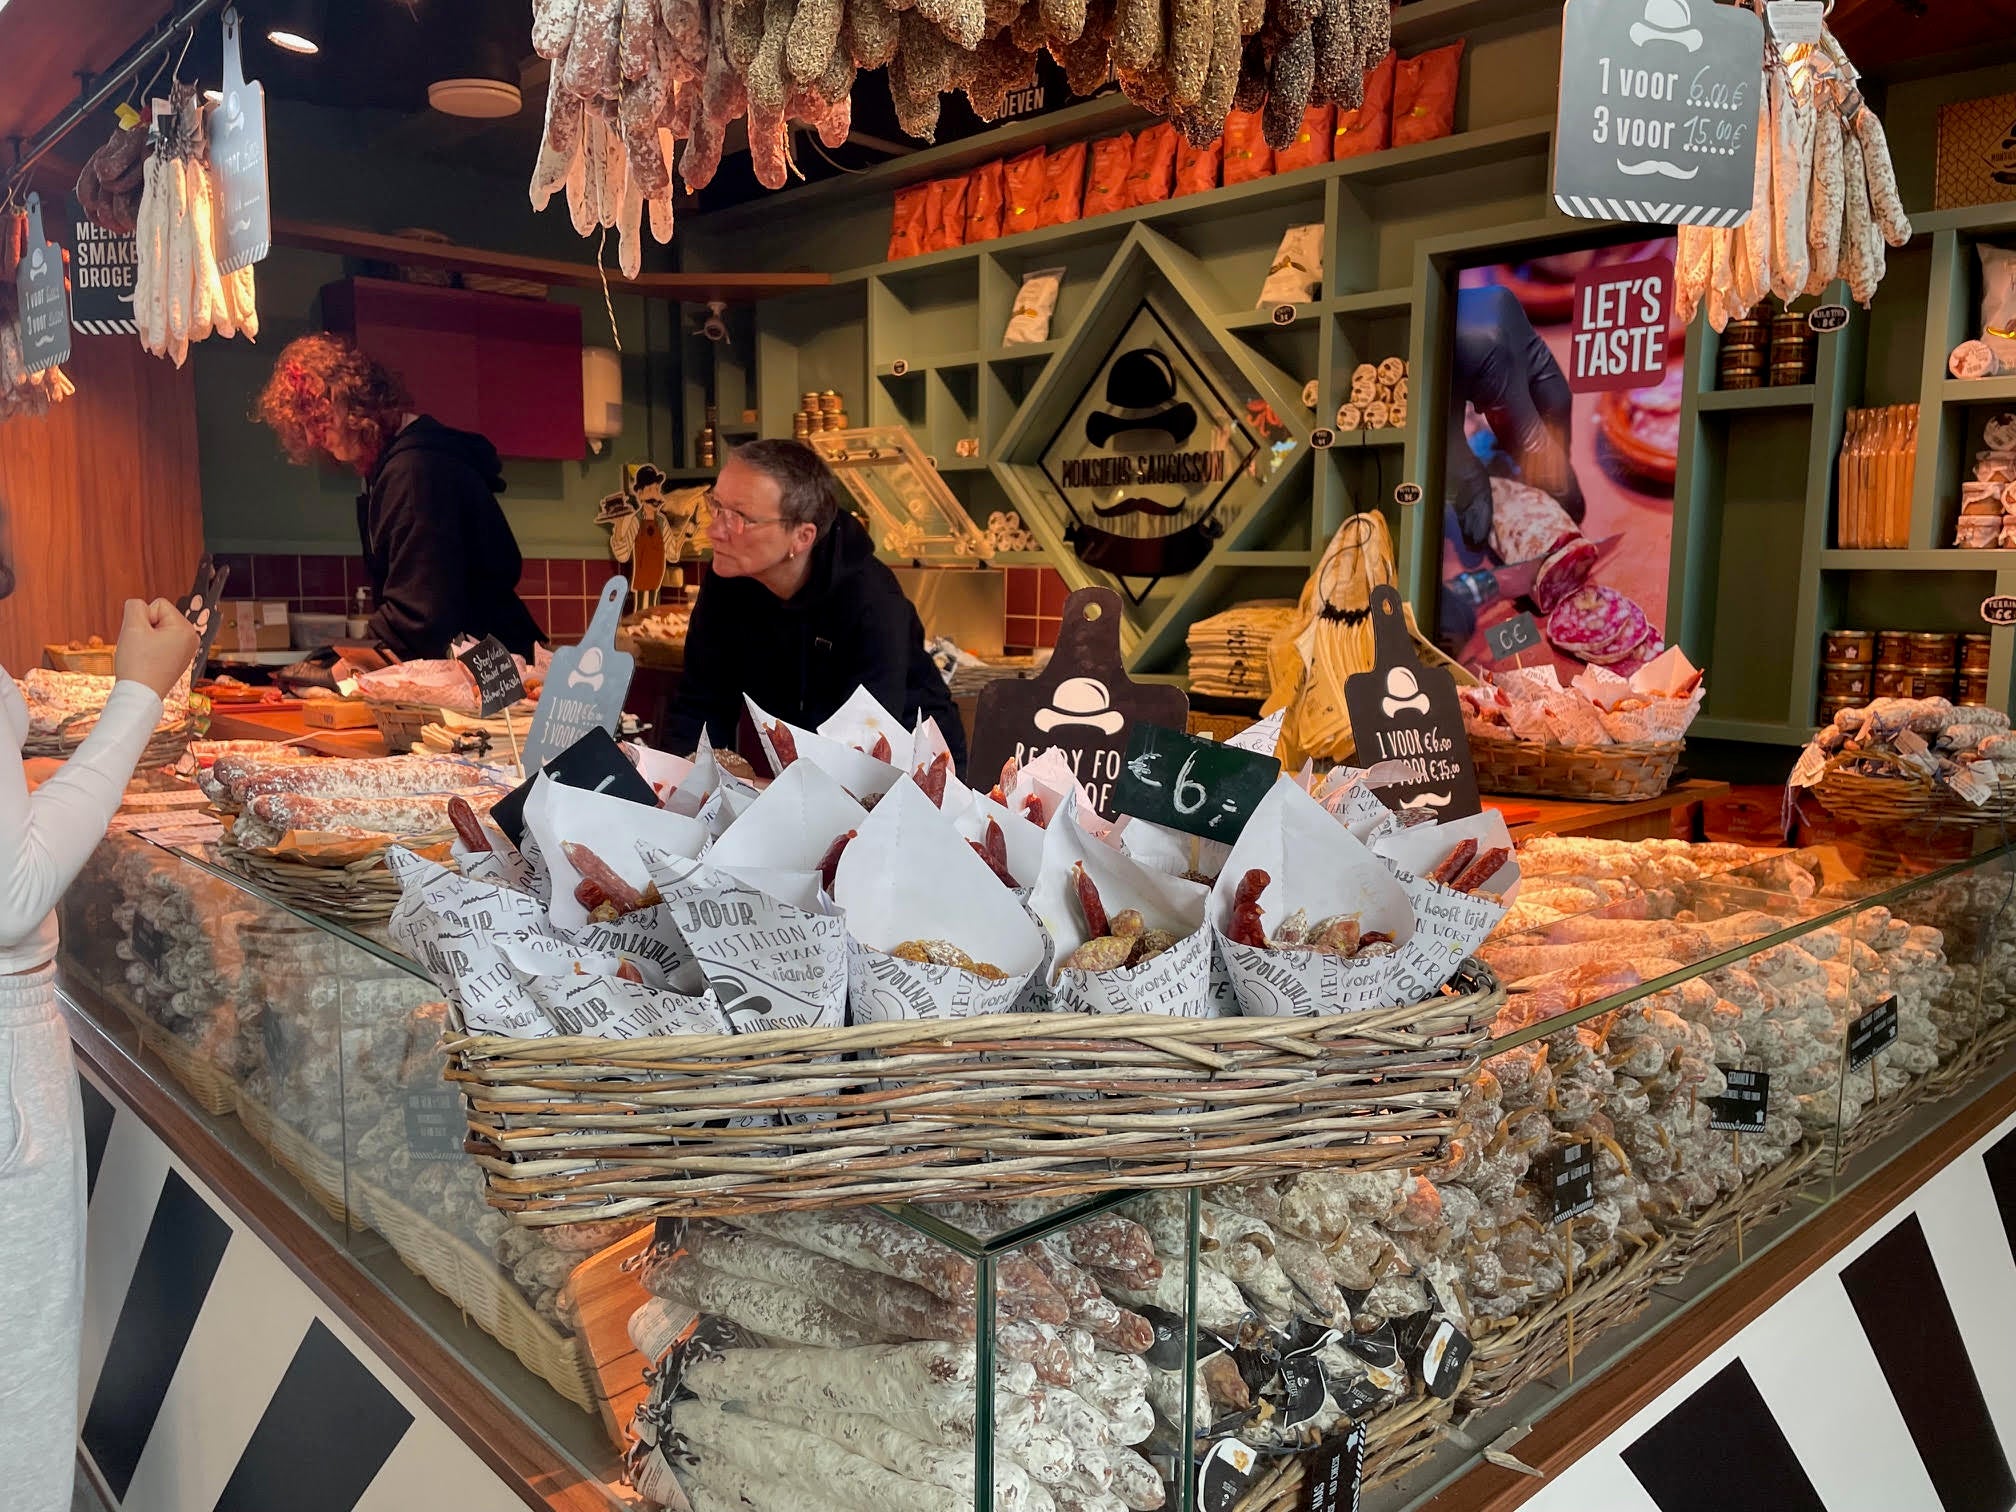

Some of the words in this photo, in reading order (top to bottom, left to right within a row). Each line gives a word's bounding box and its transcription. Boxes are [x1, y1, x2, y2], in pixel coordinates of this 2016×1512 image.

[1598, 57, 1611, 95] 1
[1619, 68, 1679, 101] voor
[1592, 105, 1610, 144] 3
[1616, 117, 1676, 150] voor
[79, 266, 132, 288] DROGE
[1582, 276, 1662, 331] LET'S
[1575, 324, 1665, 378] TASTE
[1063, 456, 1133, 488] MONSIEUR
[1137, 450, 1225, 485] SAUCISSON
[1015, 741, 1084, 778] REDY
[1387, 728, 1424, 758] VOOR
[681, 898, 758, 934] JOUR
[1433, 923, 1471, 943] WORST
[580, 925, 681, 976] UTHENTIQUE
[770, 942, 825, 967] SMAAK
[1159, 978, 1189, 1005] EEN
[1232, 947, 1314, 1017] UTHENTIQUE
